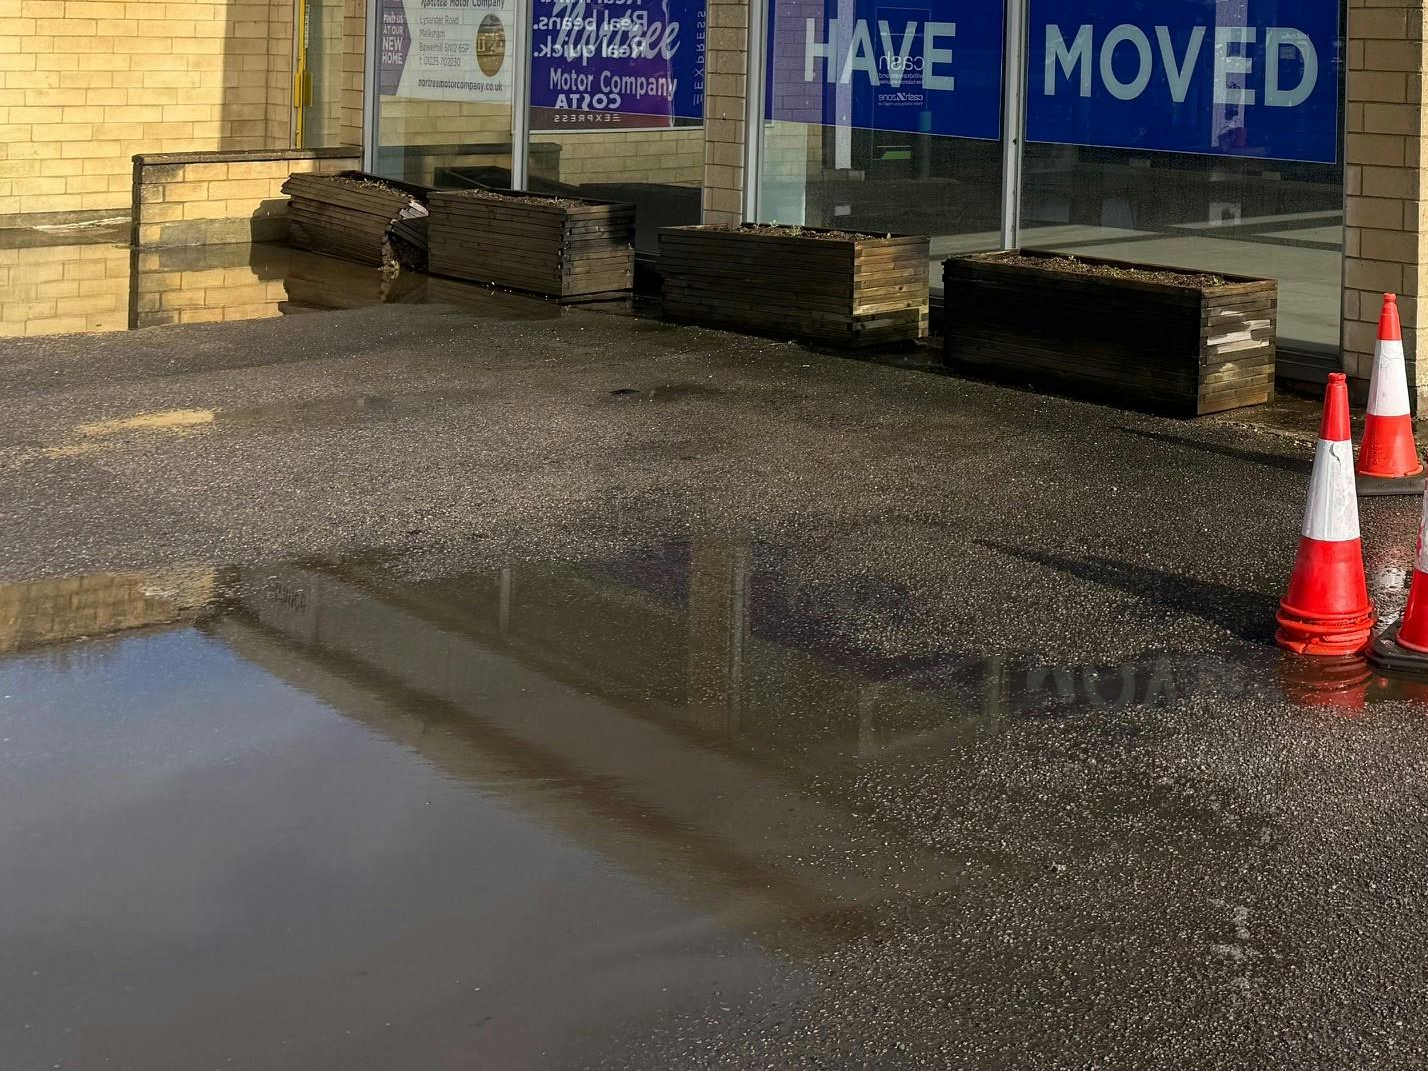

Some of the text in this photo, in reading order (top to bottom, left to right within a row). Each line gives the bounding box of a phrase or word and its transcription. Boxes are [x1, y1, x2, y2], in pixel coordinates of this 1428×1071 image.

[383, 15, 404, 23] FIND US
[445, 15, 459, 25] Road
[383, 26, 403, 35] AT OUR
[382, 37, 403, 51] NEW
[382, 53, 404, 65] HOME
[804, 18, 957, 91] HAVE
[1044, 24, 1318, 107] MOVED
[418, 78, 503, 93] nortreemotorcompany.co.uk
[550, 67, 678, 101] Motor Company
